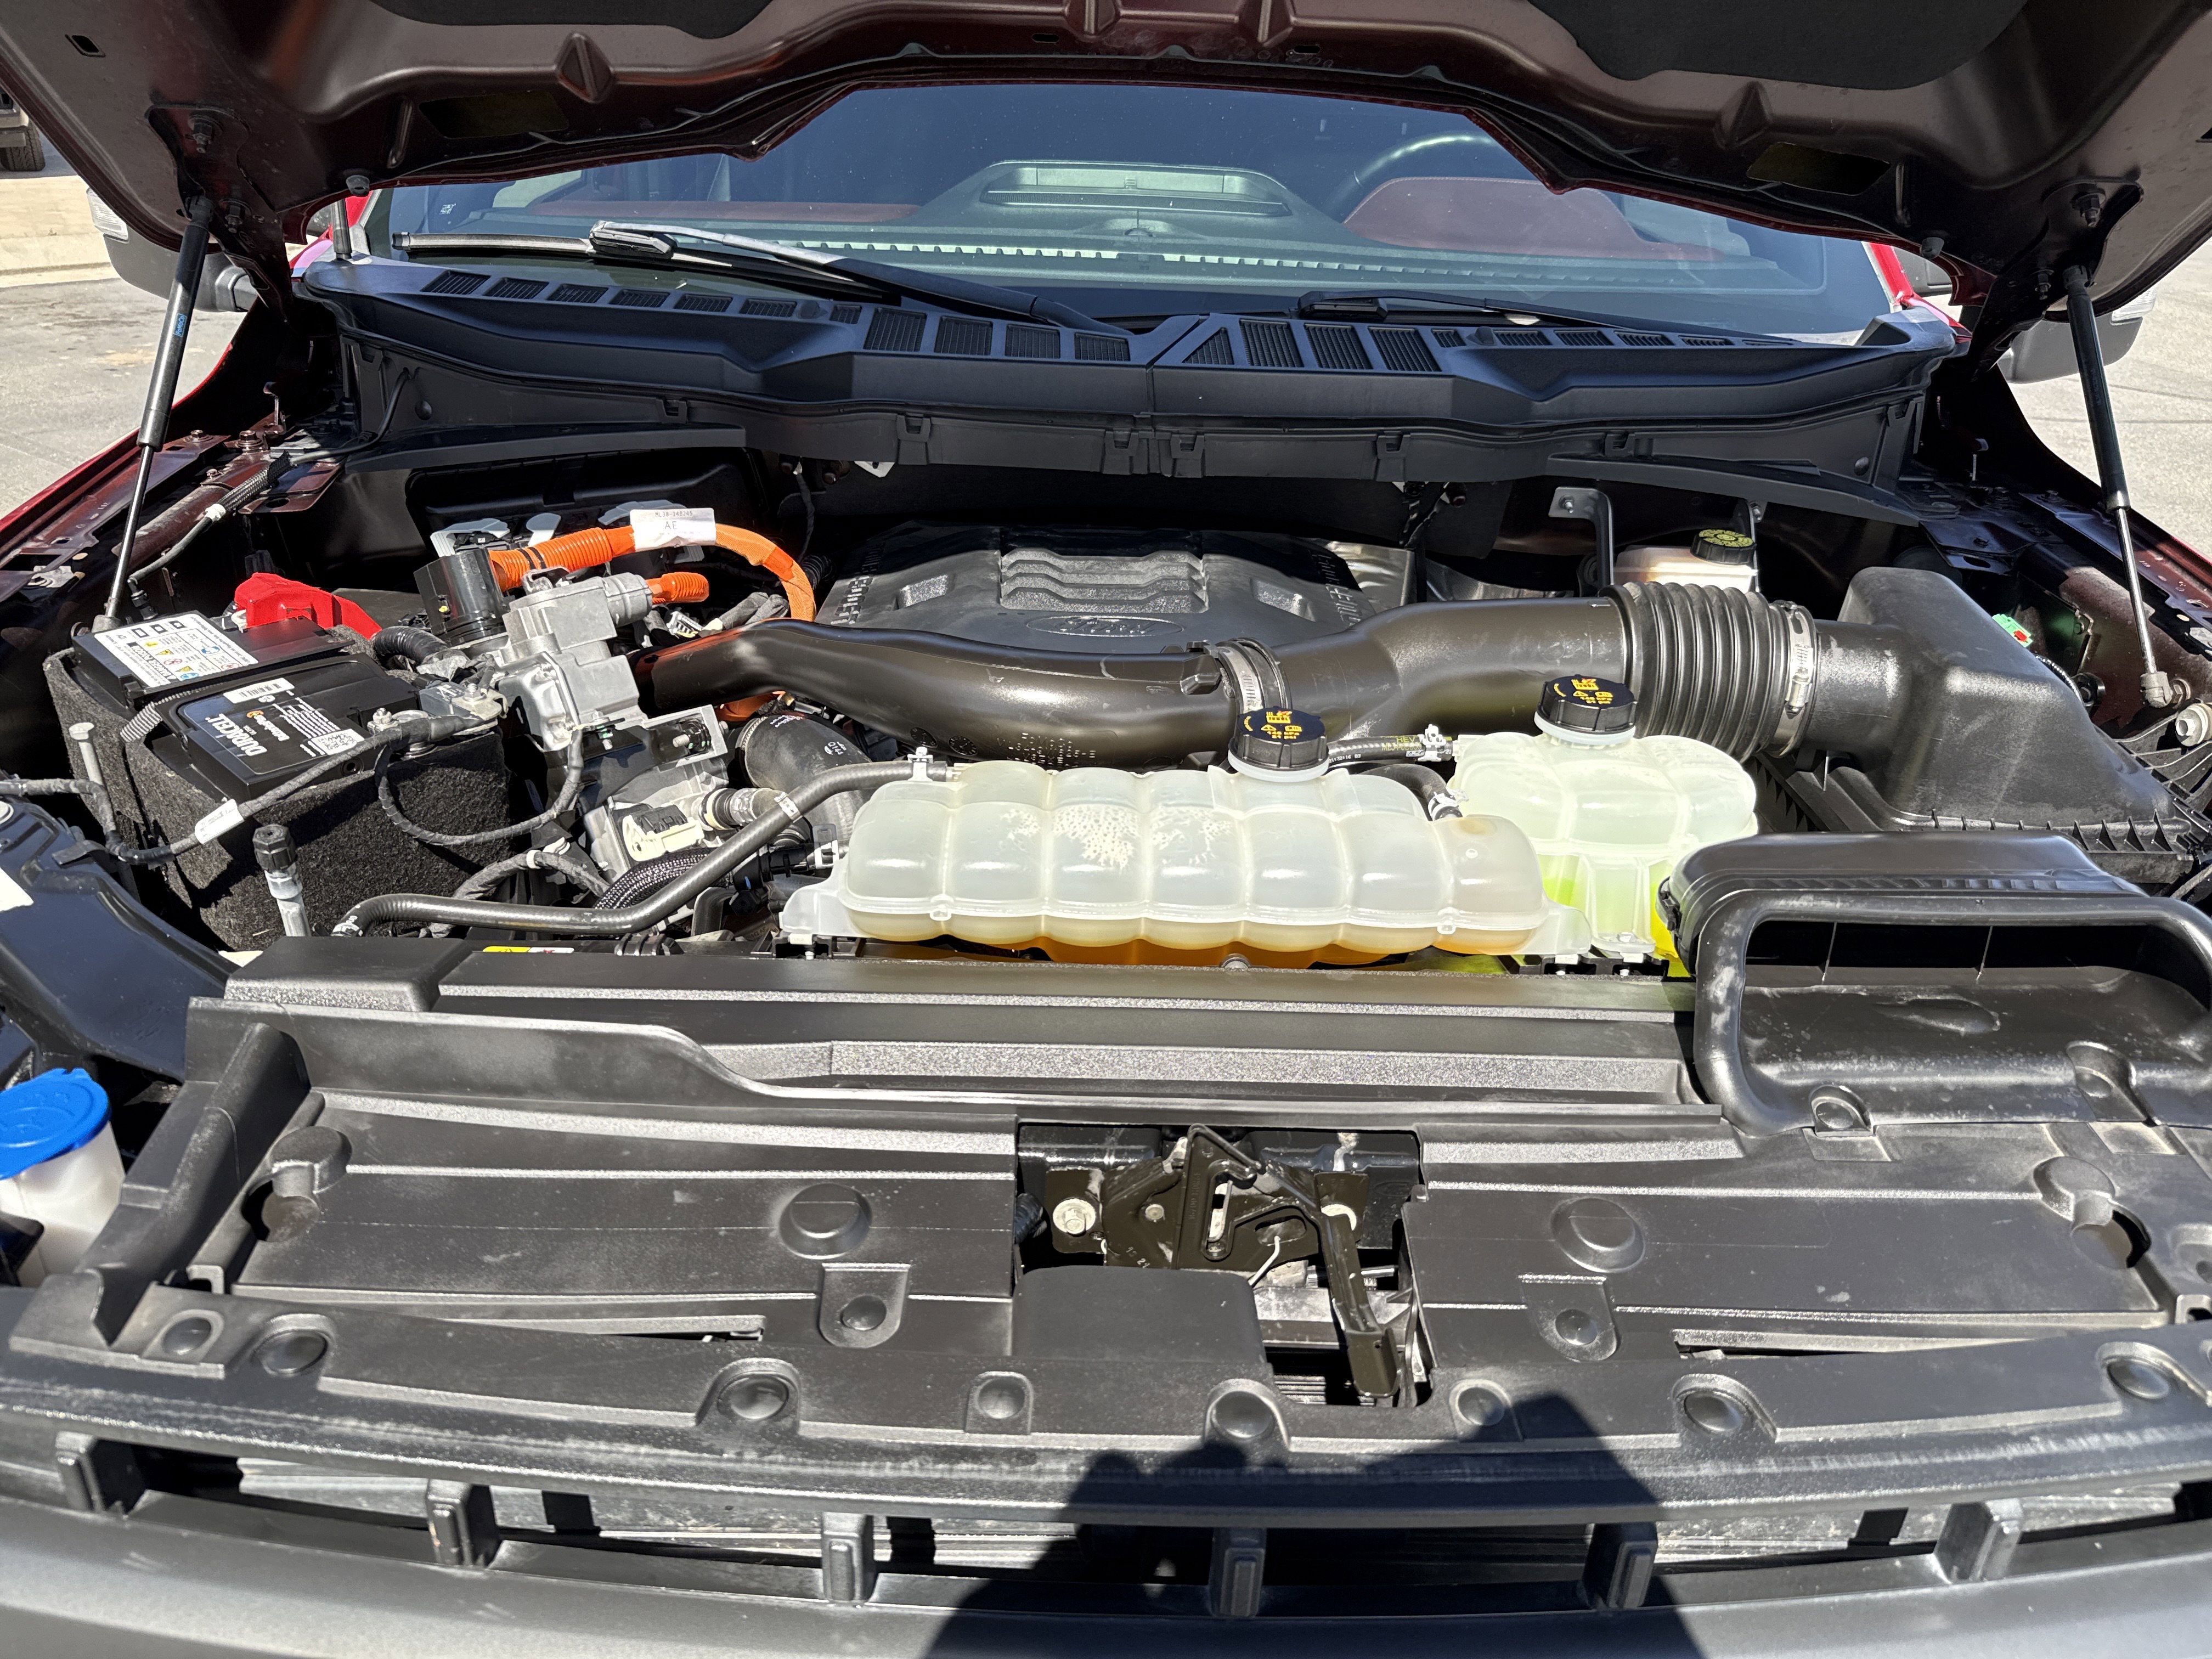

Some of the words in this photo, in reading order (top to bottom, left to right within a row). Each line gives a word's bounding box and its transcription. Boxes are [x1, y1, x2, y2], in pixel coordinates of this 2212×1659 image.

[176, 316, 185, 335] FoMoCo
[665, 521, 678, 529] AE
[1054, 617, 1159, 634] Ford
[207, 713, 268, 757] DURACELL
